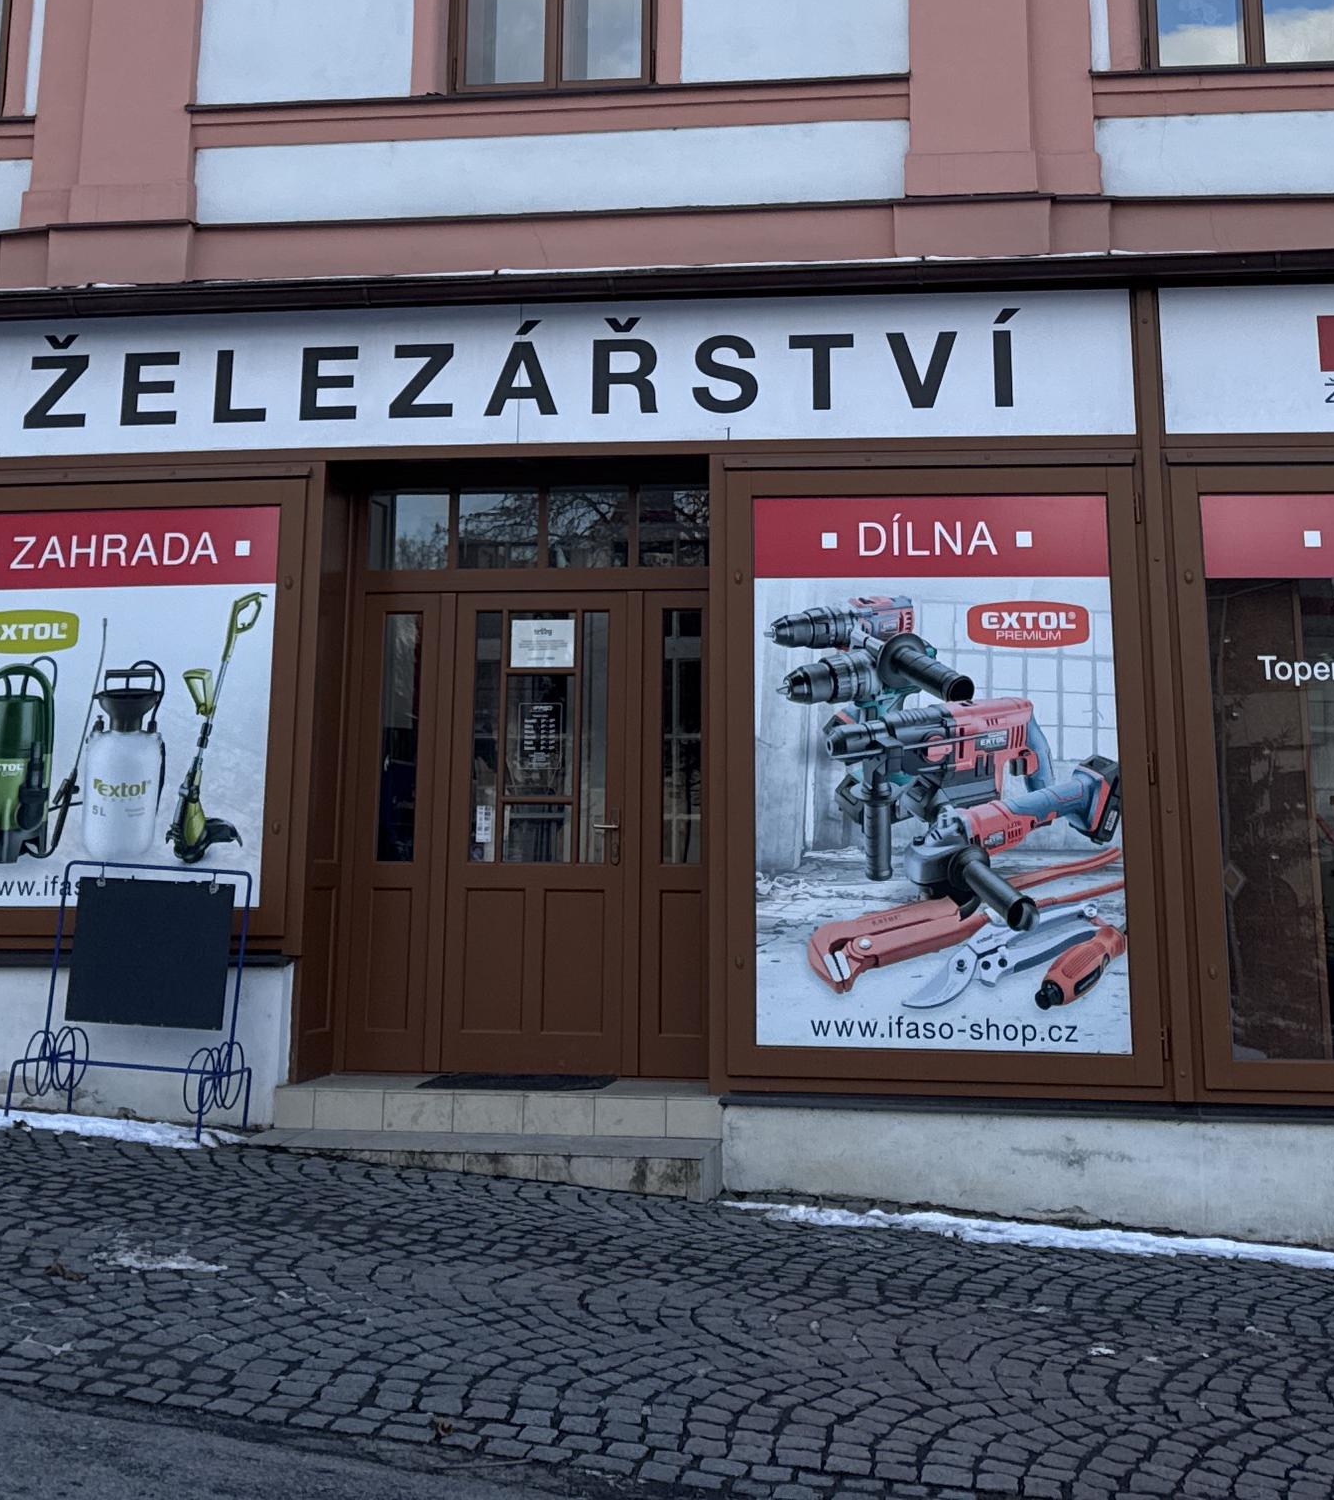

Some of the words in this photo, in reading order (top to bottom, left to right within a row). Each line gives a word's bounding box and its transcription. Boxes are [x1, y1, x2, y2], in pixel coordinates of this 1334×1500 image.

[22, 306, 1021, 430] ŽELEZÁŘSTVÍ
[9, 531, 219, 570] ZAHRADA
[858, 512, 999, 557] DÍLNA
[981, 611, 1077, 630] EXTOL
[995, 630, 1062, 641] PREMIUM
[810, 1015, 1079, 1047] www.ifaso-shop.cz
